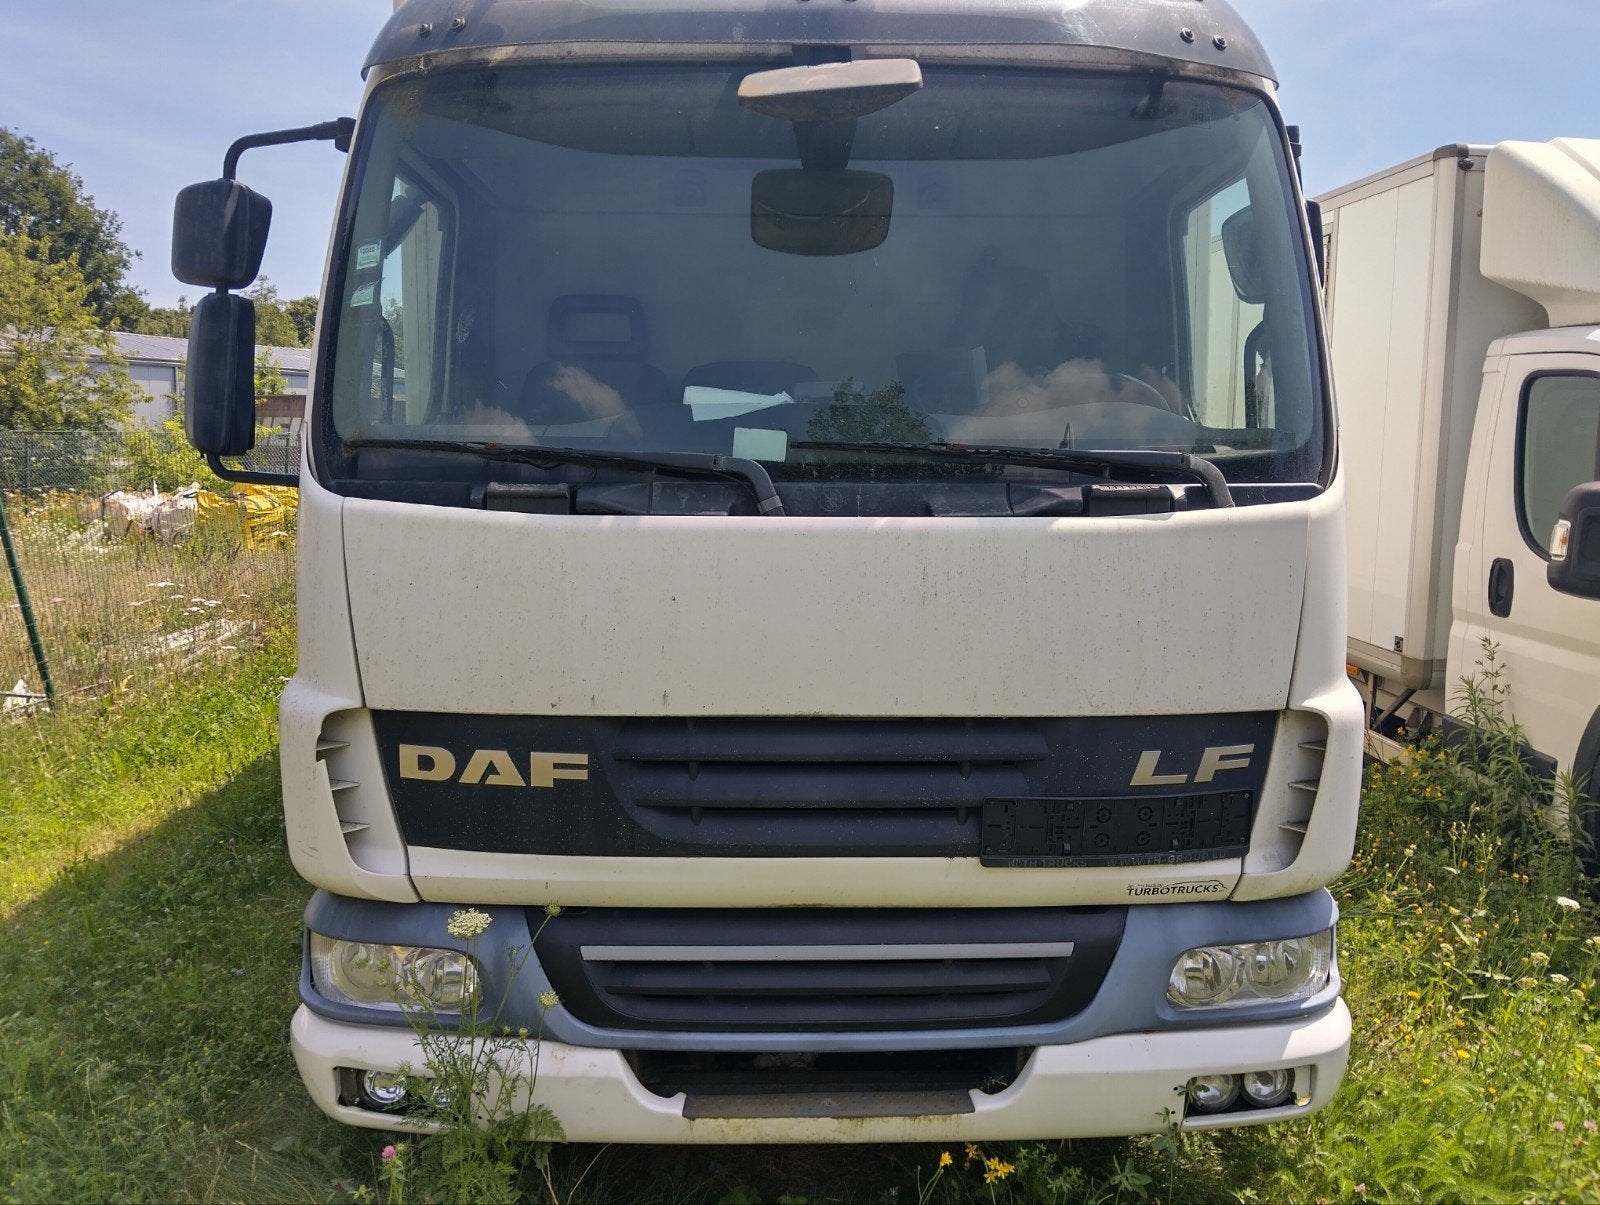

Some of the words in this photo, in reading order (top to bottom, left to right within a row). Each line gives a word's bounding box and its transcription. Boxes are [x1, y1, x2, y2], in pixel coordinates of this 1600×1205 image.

[399, 743, 589, 788] DAF
[1129, 743, 1255, 785] LF
[1041, 858, 1087, 867] TRUCKS
[1127, 884, 1219, 896] TURBOTRUCKS
